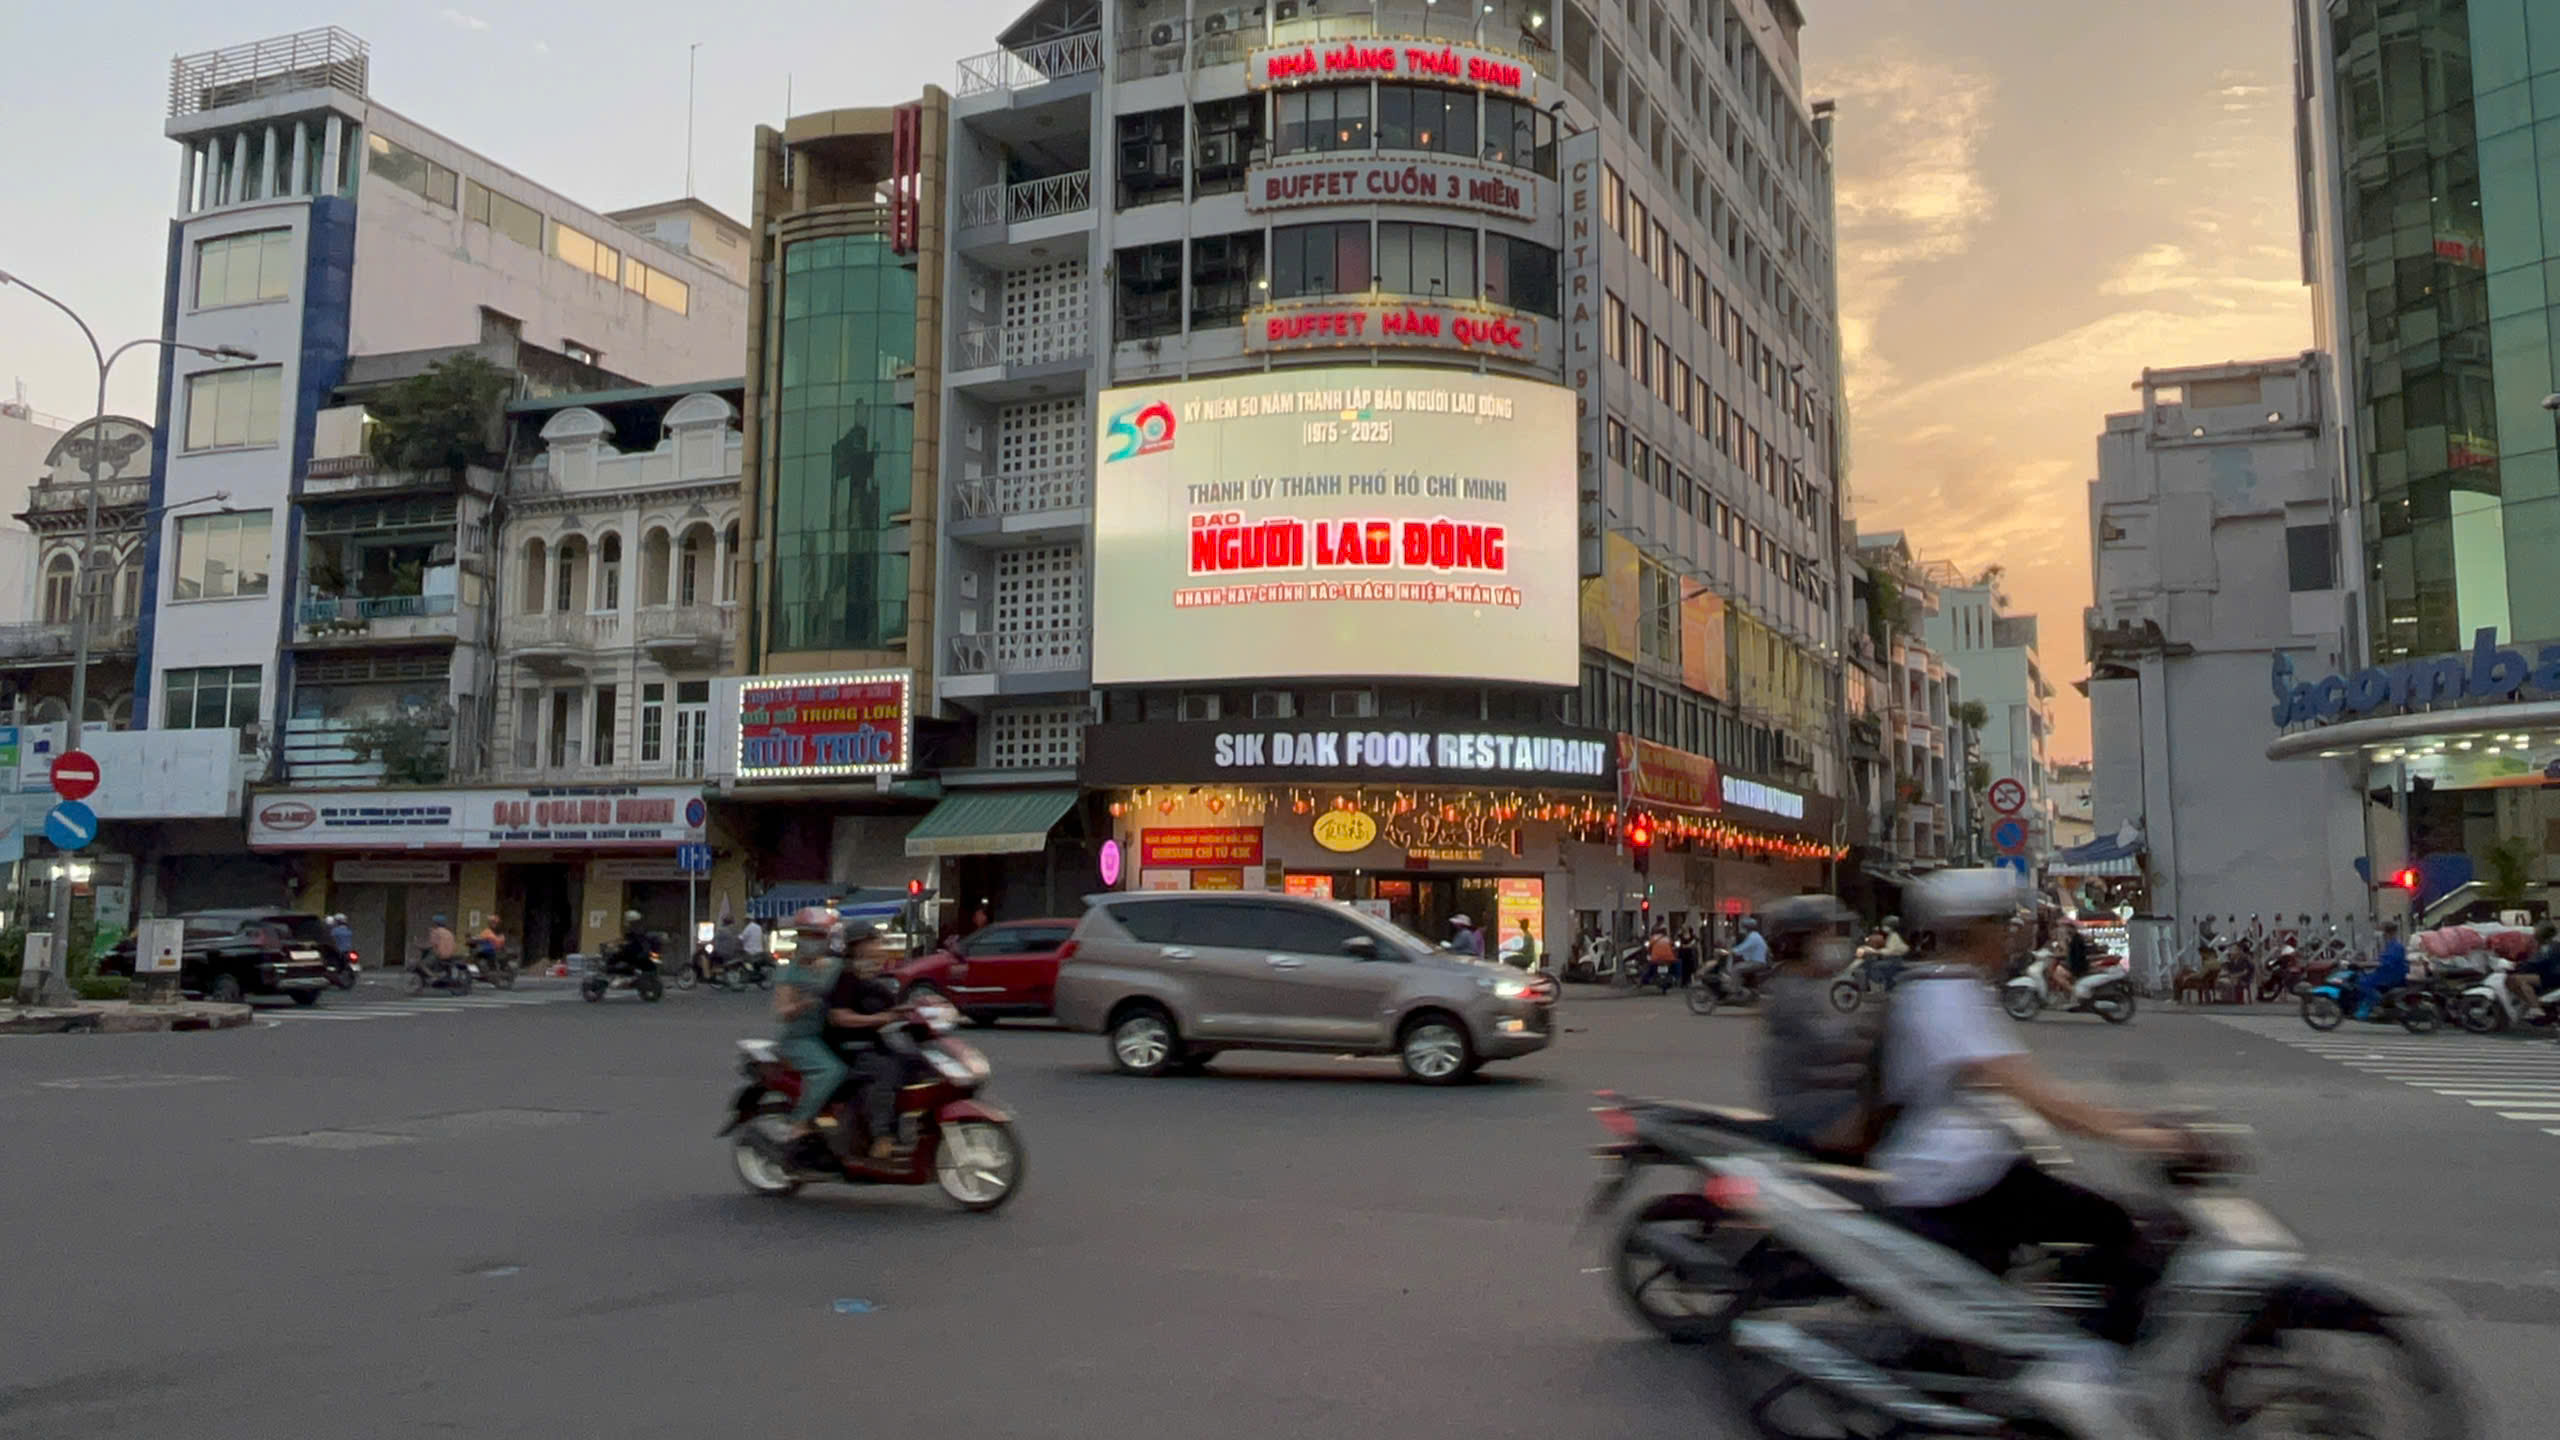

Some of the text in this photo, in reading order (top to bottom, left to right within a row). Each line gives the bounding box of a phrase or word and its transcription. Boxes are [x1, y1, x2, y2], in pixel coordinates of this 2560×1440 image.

[1267, 43, 1522, 88] NHÀ HÀNG THÁI SIAM
[1266, 166, 1520, 210] BUFFET CUỐN 3 MIỀN
[1572, 162, 1591, 353] CENTRAL
[1266, 307, 1523, 349] BUFFET HÀN QUỐC
[1240, 396, 1258, 416] 50
[1451, 393, 1475, 414] LAO
[1426, 472, 1457, 497] CHÍ
[1463, 477, 1507, 502] MINH
[1191, 518, 1504, 573] NGƯỜI LAO ĐỘNG
[1214, 733, 1266, 768] SIK
[1272, 731, 1340, 767] DAK
[1346, 731, 1432, 768] FOOK
[1437, 732, 1607, 777] RESTAURANT
